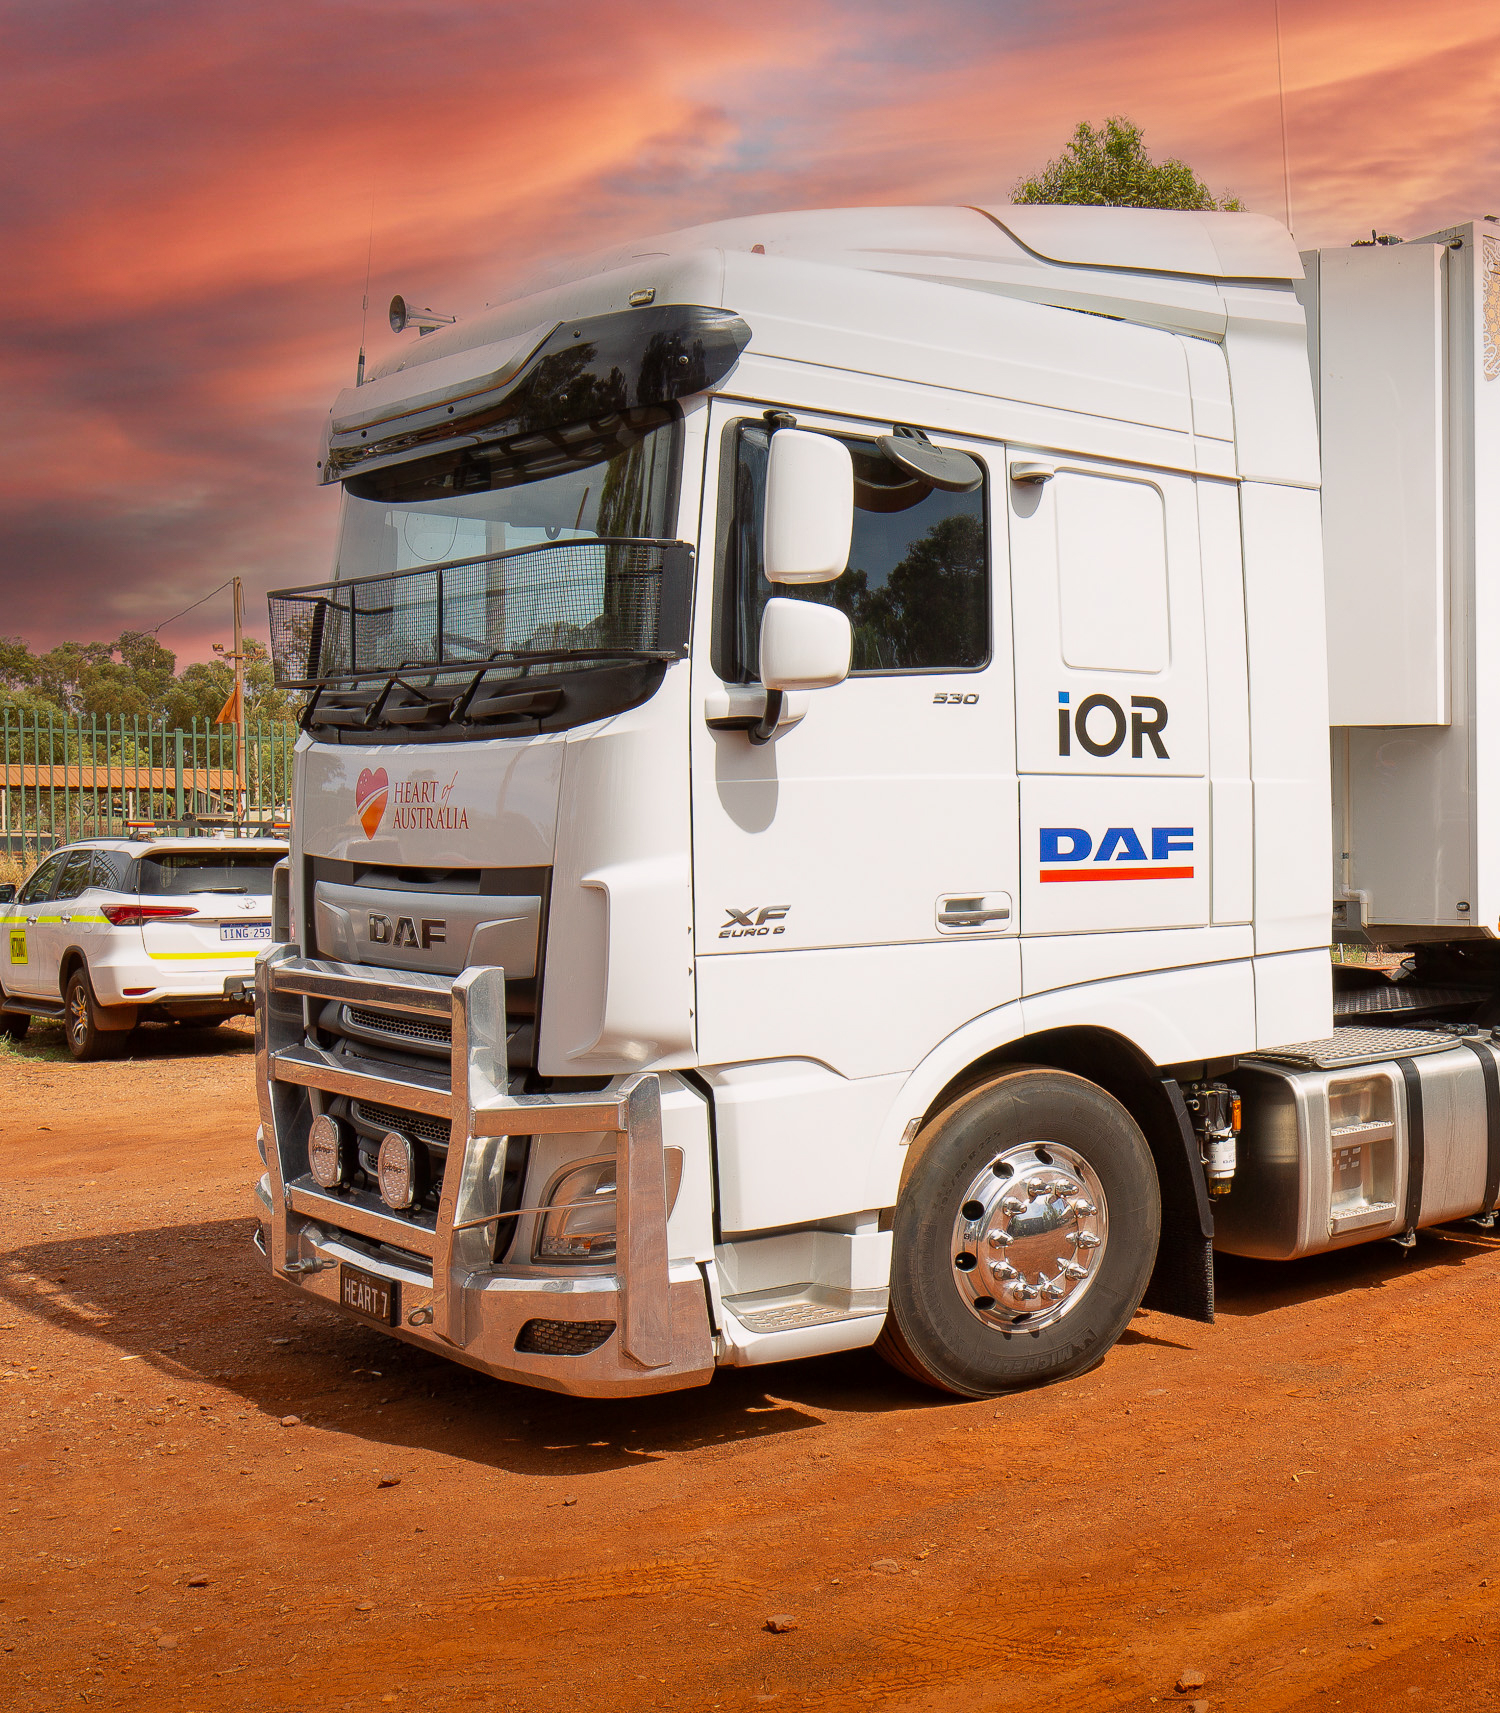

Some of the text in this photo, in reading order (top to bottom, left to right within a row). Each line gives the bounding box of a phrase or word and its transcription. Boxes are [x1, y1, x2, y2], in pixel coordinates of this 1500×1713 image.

[932, 692, 980, 705] 530
[1057, 690, 1171, 760] iOR
[393, 769, 459, 814] HEART of
[391, 806, 470, 830] AUSTRALIA
[1039, 827, 1194, 863] DAF
[368, 912, 447, 951] DAF
[720, 904, 792, 929] XF
[253, 928, 271, 938] 259
[718, 927, 770, 939] EURO
[344, 1276, 388, 1318] HEART 7
